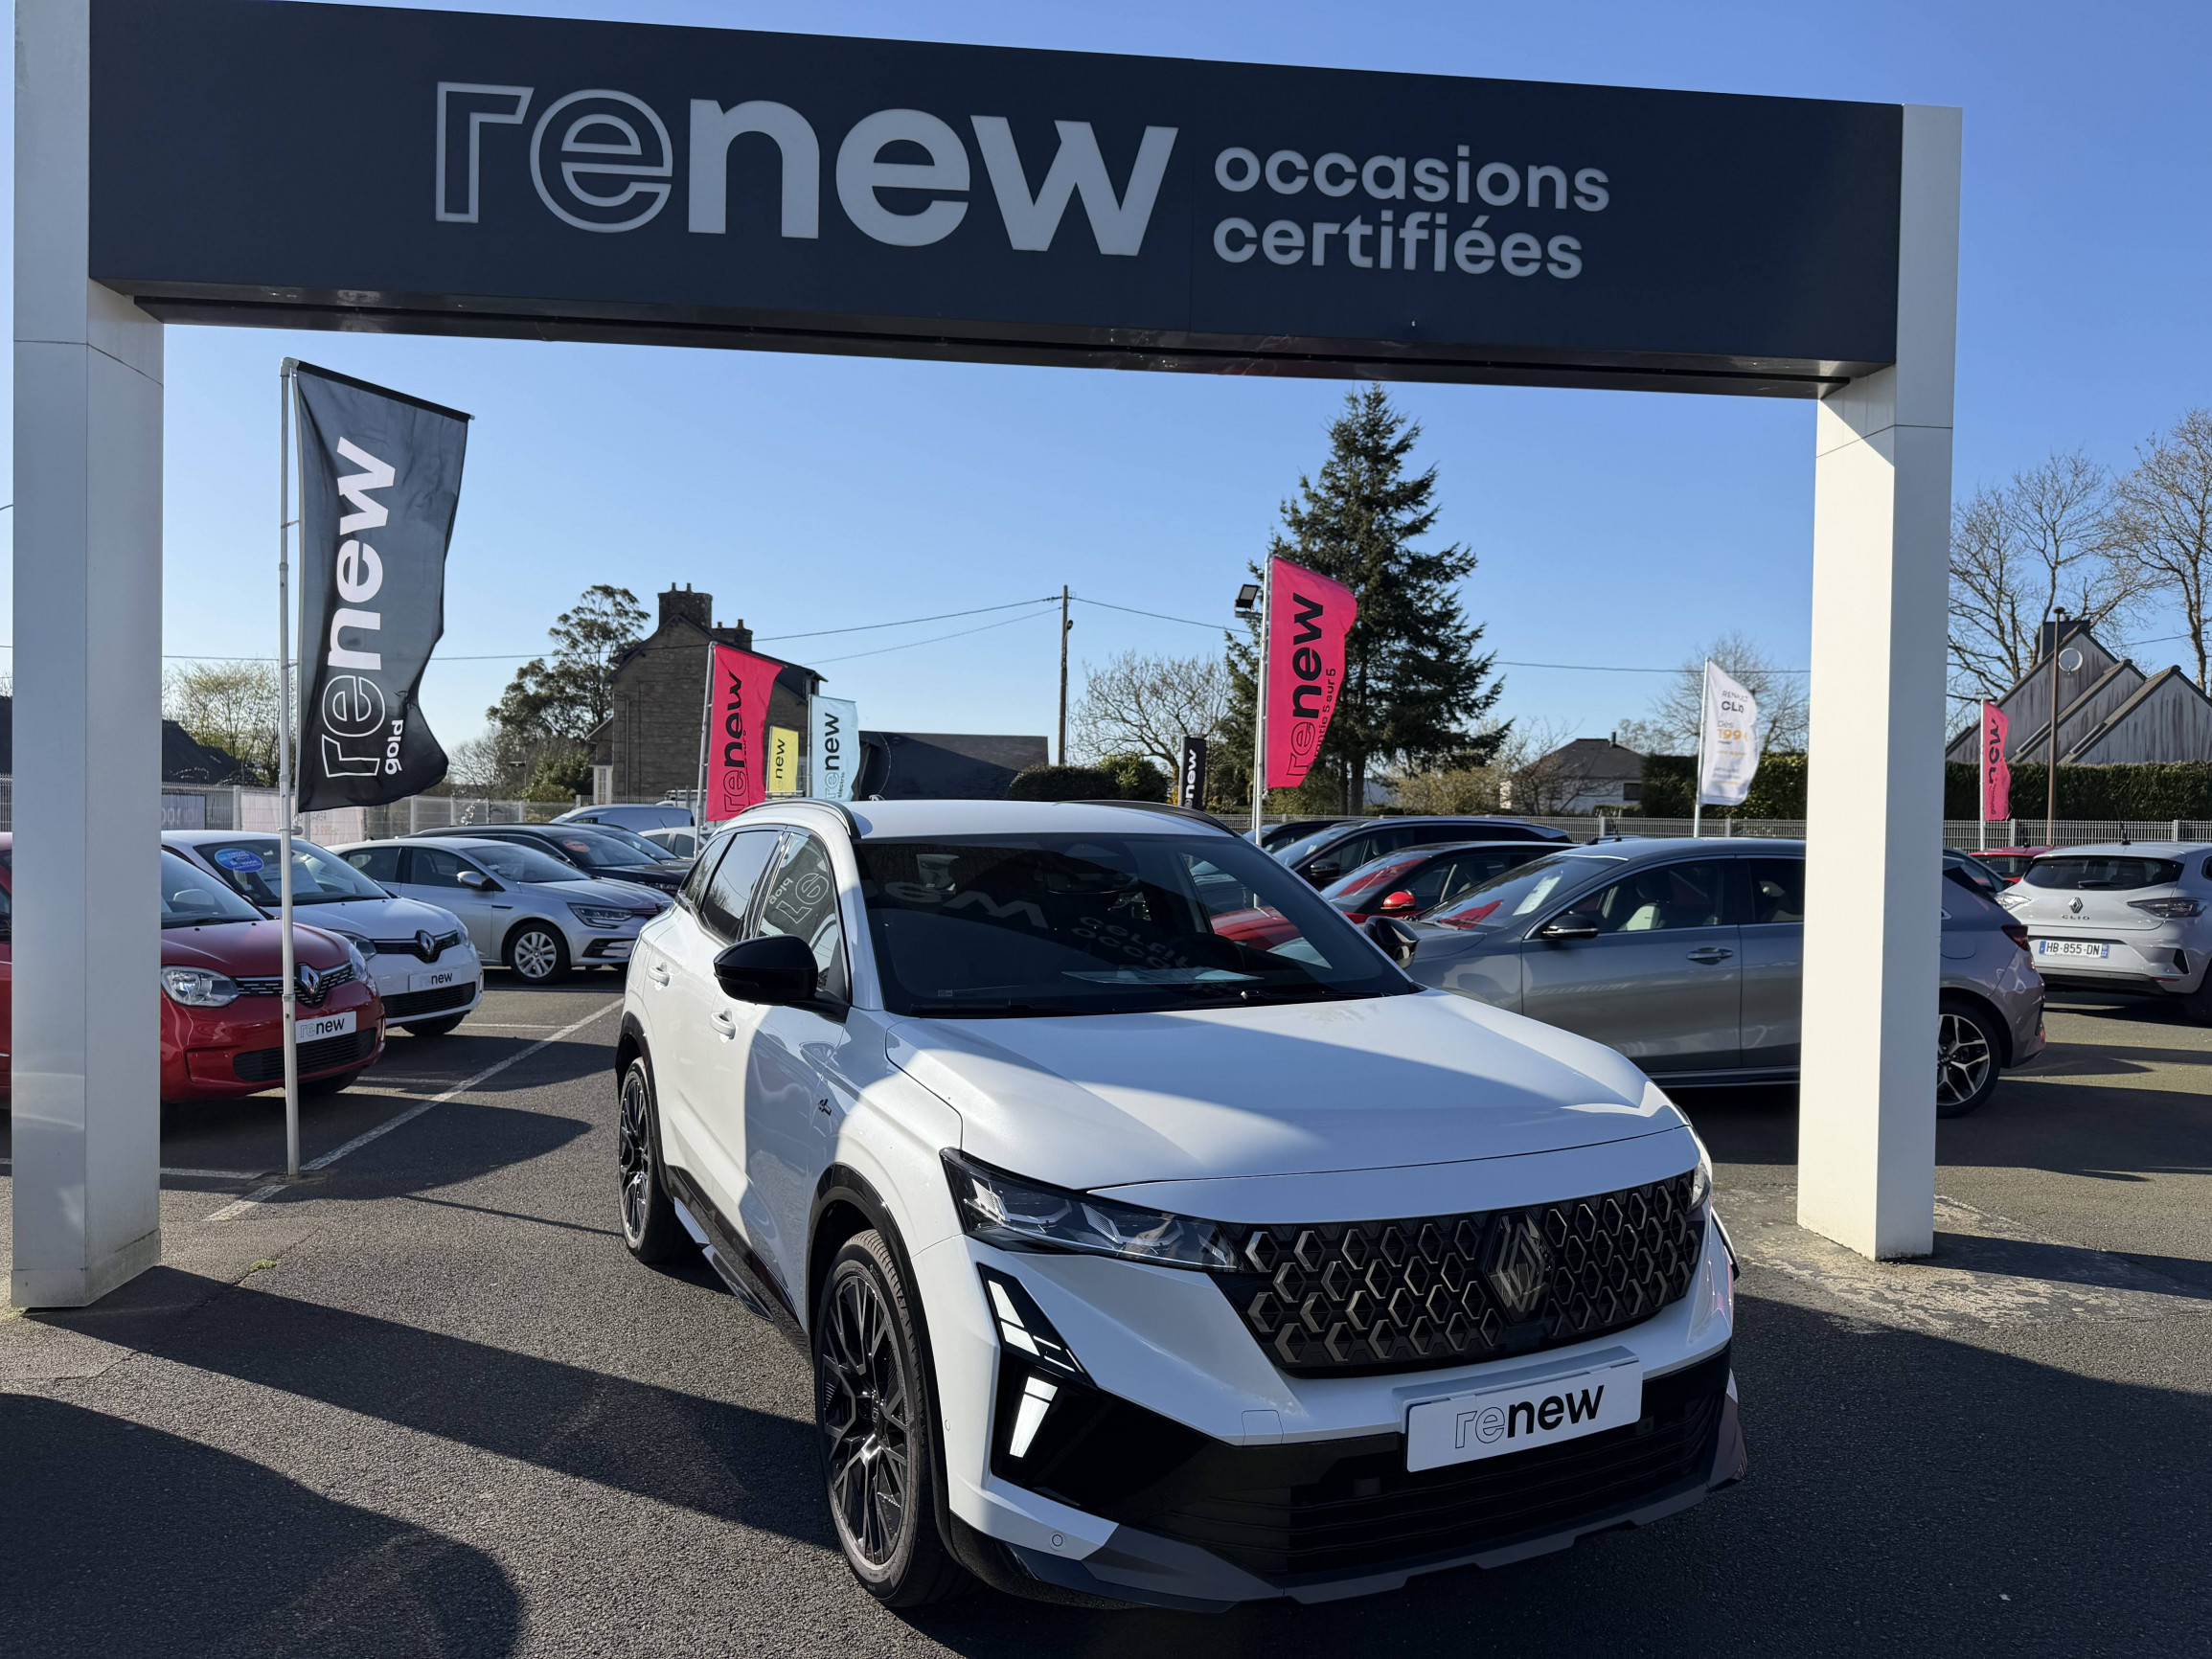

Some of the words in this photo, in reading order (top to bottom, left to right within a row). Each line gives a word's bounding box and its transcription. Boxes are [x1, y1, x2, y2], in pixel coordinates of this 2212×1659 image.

[435, 81, 1179, 256] renew
[1214, 145, 1610, 212] occasions
[1213, 209, 1583, 280] certifiées
[322, 437, 396, 779] renew
[1287, 593, 1324, 777] renew
[385, 719, 403, 775] gold
[723, 670, 746, 812] renew
[825, 712, 840, 800] renew
[1989, 717, 2000, 784] new
[301, 1018, 345, 1039] renew
[1455, 1385, 1605, 1449] renew
